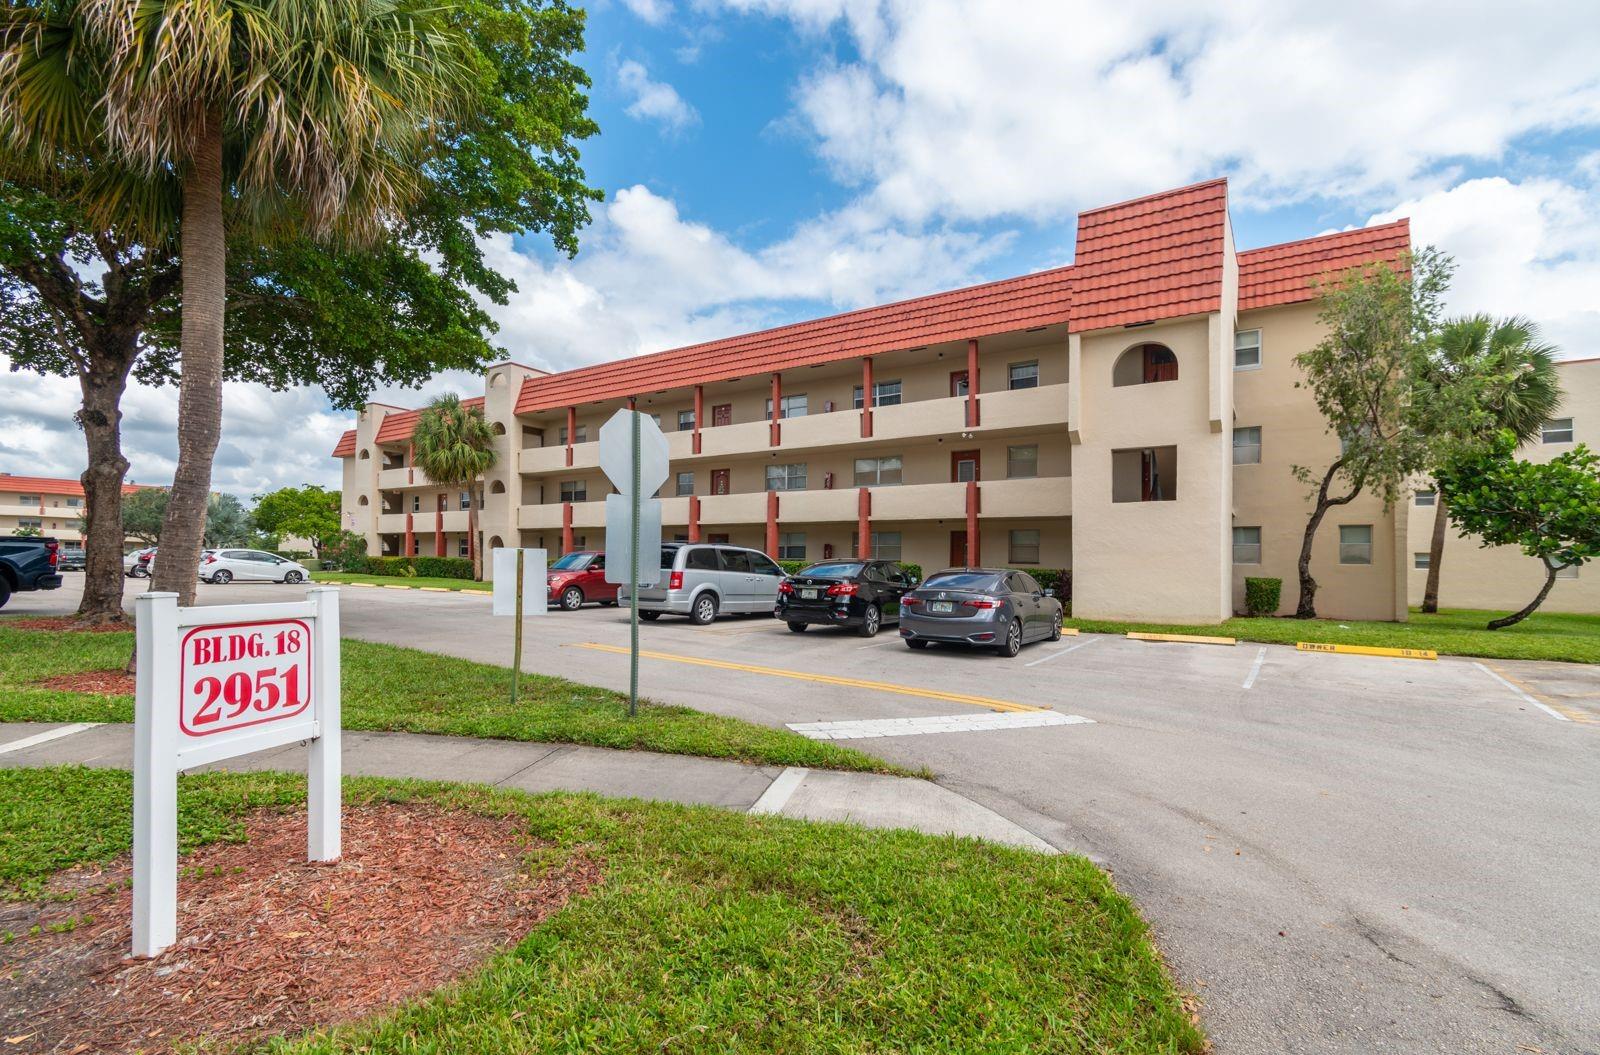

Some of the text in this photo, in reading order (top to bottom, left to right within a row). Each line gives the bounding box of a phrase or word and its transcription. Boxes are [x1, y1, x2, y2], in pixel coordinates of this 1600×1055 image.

[192, 629, 301, 666] BLDG. 18
[192, 663, 301, 726] 2951
